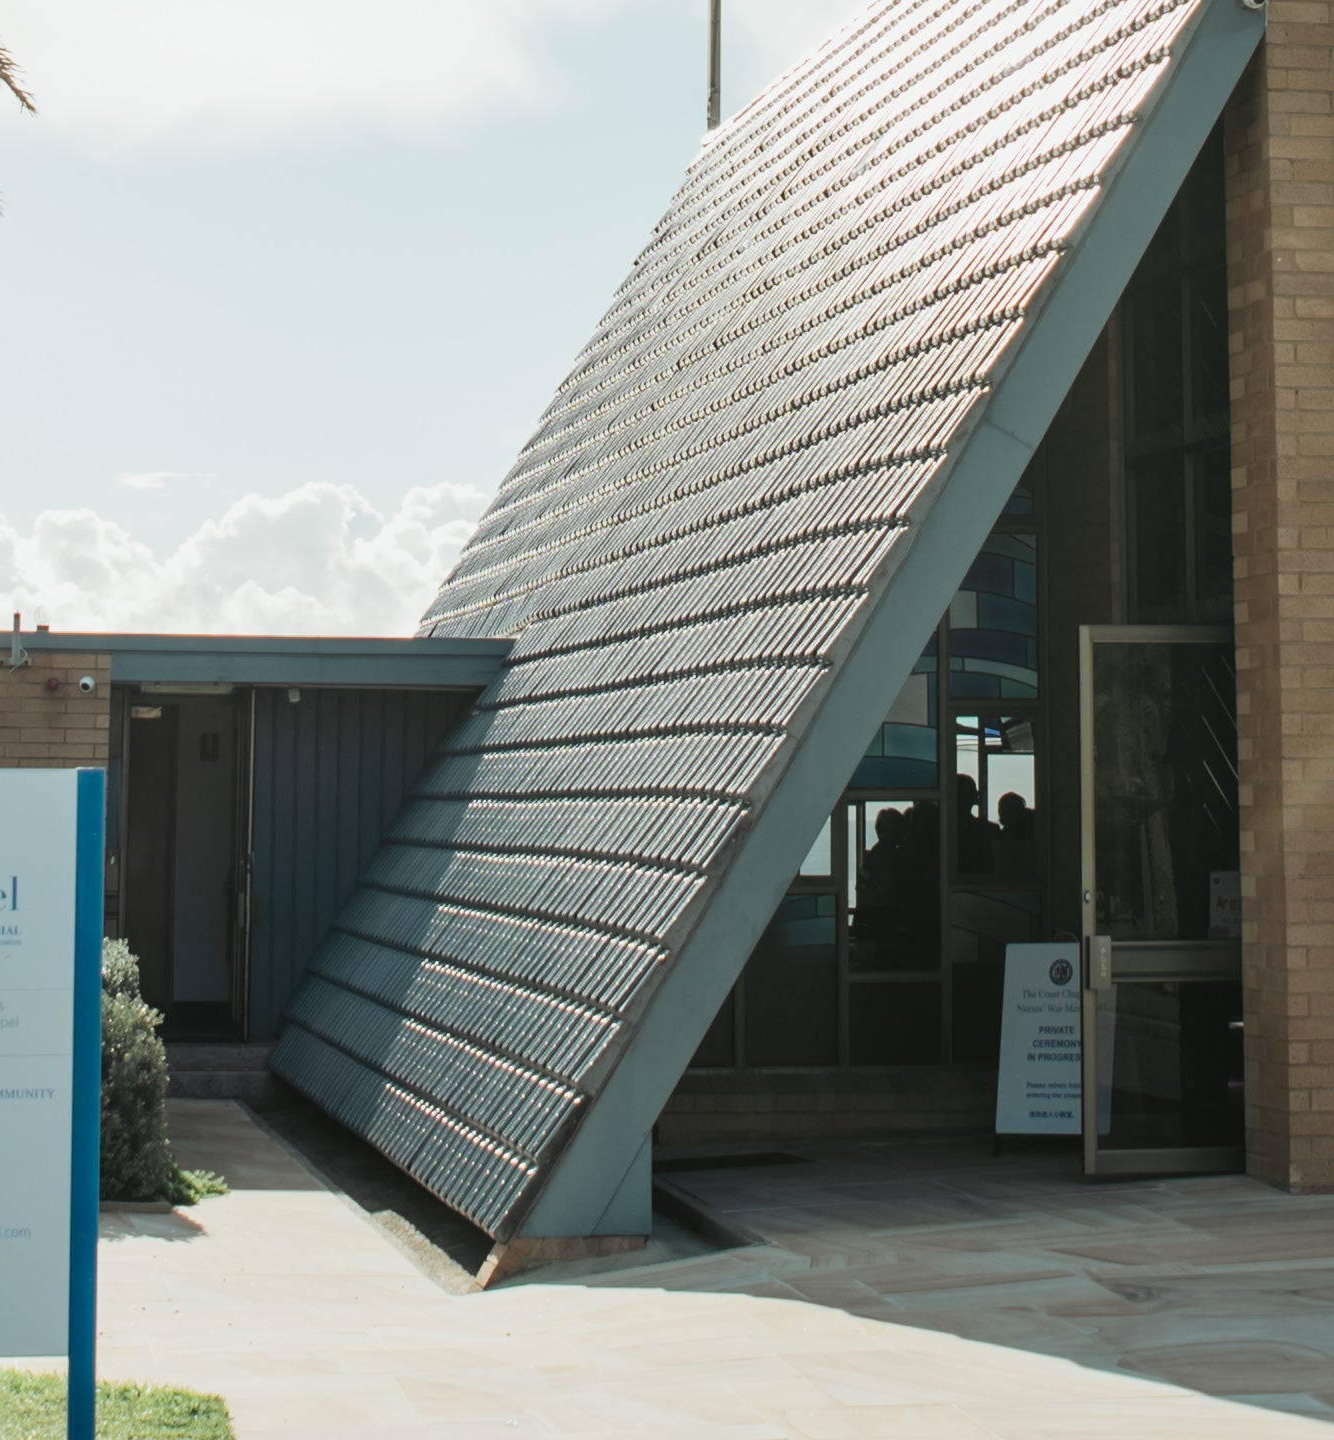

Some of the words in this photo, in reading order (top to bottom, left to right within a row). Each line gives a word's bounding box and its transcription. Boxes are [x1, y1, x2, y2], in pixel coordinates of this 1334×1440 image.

[1022, 989, 1036, 999] The
[1061, 989, 1082, 1001] Chap
[1038, 1025, 1075, 1035] PRIVATE
[1032, 1039, 1082, 1048] CEREMONY
[1026, 1053, 1036, 1062] IN
[1037, 1053, 1082, 1062] PROGRES
